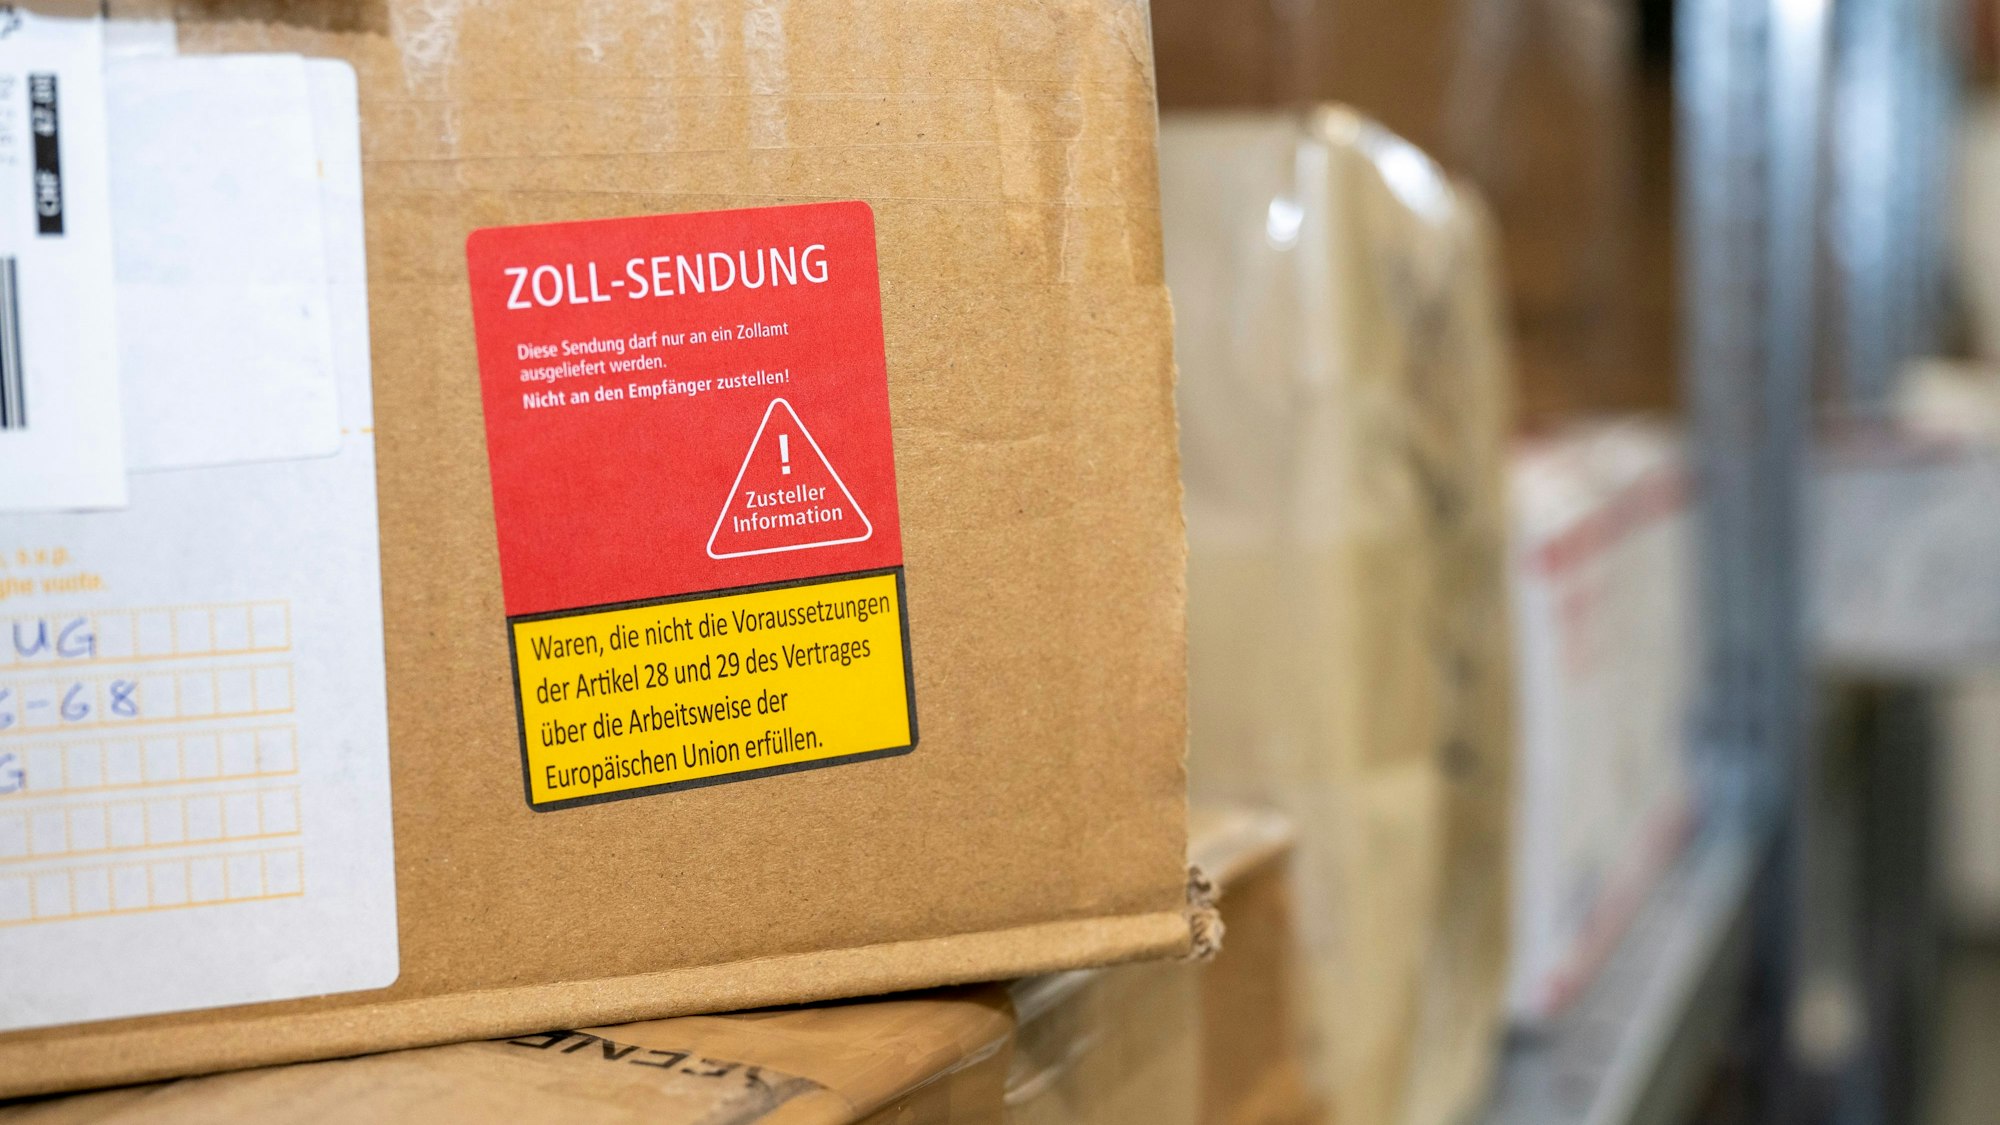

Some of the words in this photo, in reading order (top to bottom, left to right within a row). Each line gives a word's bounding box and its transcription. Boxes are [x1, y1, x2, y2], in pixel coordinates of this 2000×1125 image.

[504, 244, 828, 310] ZOLL-SENDUNG
[517, 344, 558, 360] Diese
[561, 337, 625, 356] Sendung
[628, 331, 657, 349] darf
[661, 334, 685, 346] nur
[690, 331, 707, 344] an
[711, 326, 732, 342] ein
[737, 322, 788, 339] Zollamt
[520, 359, 605, 383] ausgeliefert
[609, 354, 666, 372] werden.
[523, 390, 565, 409] Nicht
[570, 391, 590, 404] an
[594, 385, 624, 402] den
[629, 379, 712, 400] Empfänger
[717, 369, 789, 389] zustellen!
[746, 484, 826, 509] Zusteller
[733, 506, 842, 533] Information
[13, 617, 96, 658] UG
[531, 636, 603, 660] Waren,
[610, 625, 639, 650] die
[645, 617, 693, 645] nicht
[699, 613, 727, 638] die
[732, 596, 889, 633] Voraussetzungen
[537, 678, 569, 704] der
[577, 665, 639, 698] Artikel
[645, 662, 669, 688] 28
[675, 655, 711, 684] und
[716, 652, 739, 678] 29
[746, 648, 778, 674] des
[782, 640, 870, 668] Vertrages
[542, 720, 587, 747] über
[593, 713, 623, 739] die
[629, 696, 751, 734] Arbeitsweise
[757, 689, 788, 714] der
[546, 750, 677, 789] Europäischen
[683, 740, 739, 768] Union
[746, 727, 822, 758] erfüllen.
